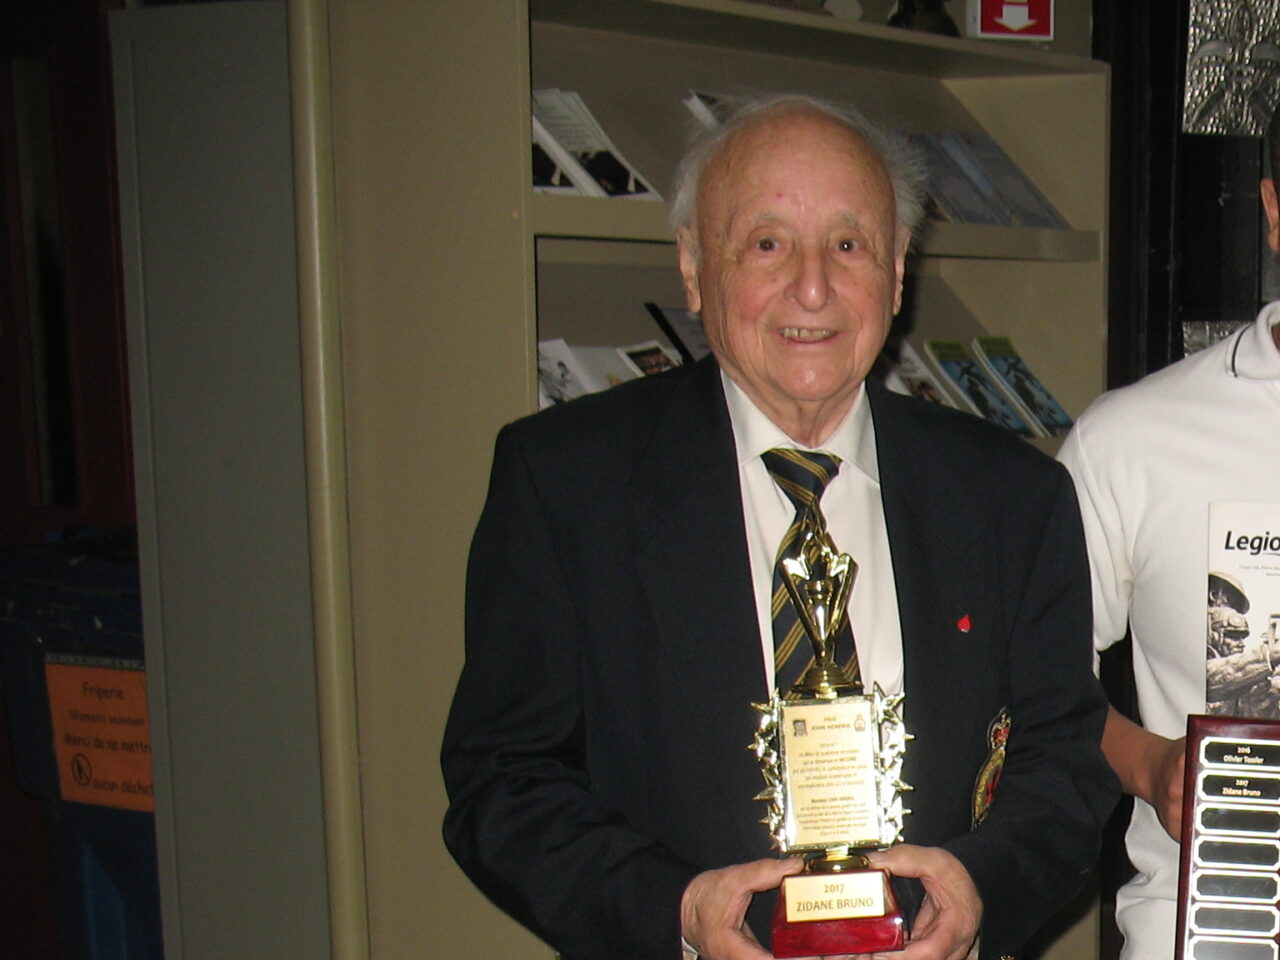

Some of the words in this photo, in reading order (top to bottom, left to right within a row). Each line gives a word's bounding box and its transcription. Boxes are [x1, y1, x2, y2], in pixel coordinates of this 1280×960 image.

[81, 681, 125, 702] Friperie
[64, 732, 91, 747] Merci
[824, 884, 845, 894] 2017
[796, 900, 834, 912] ZIDANE
[836, 897, 874, 910] BRUNO
